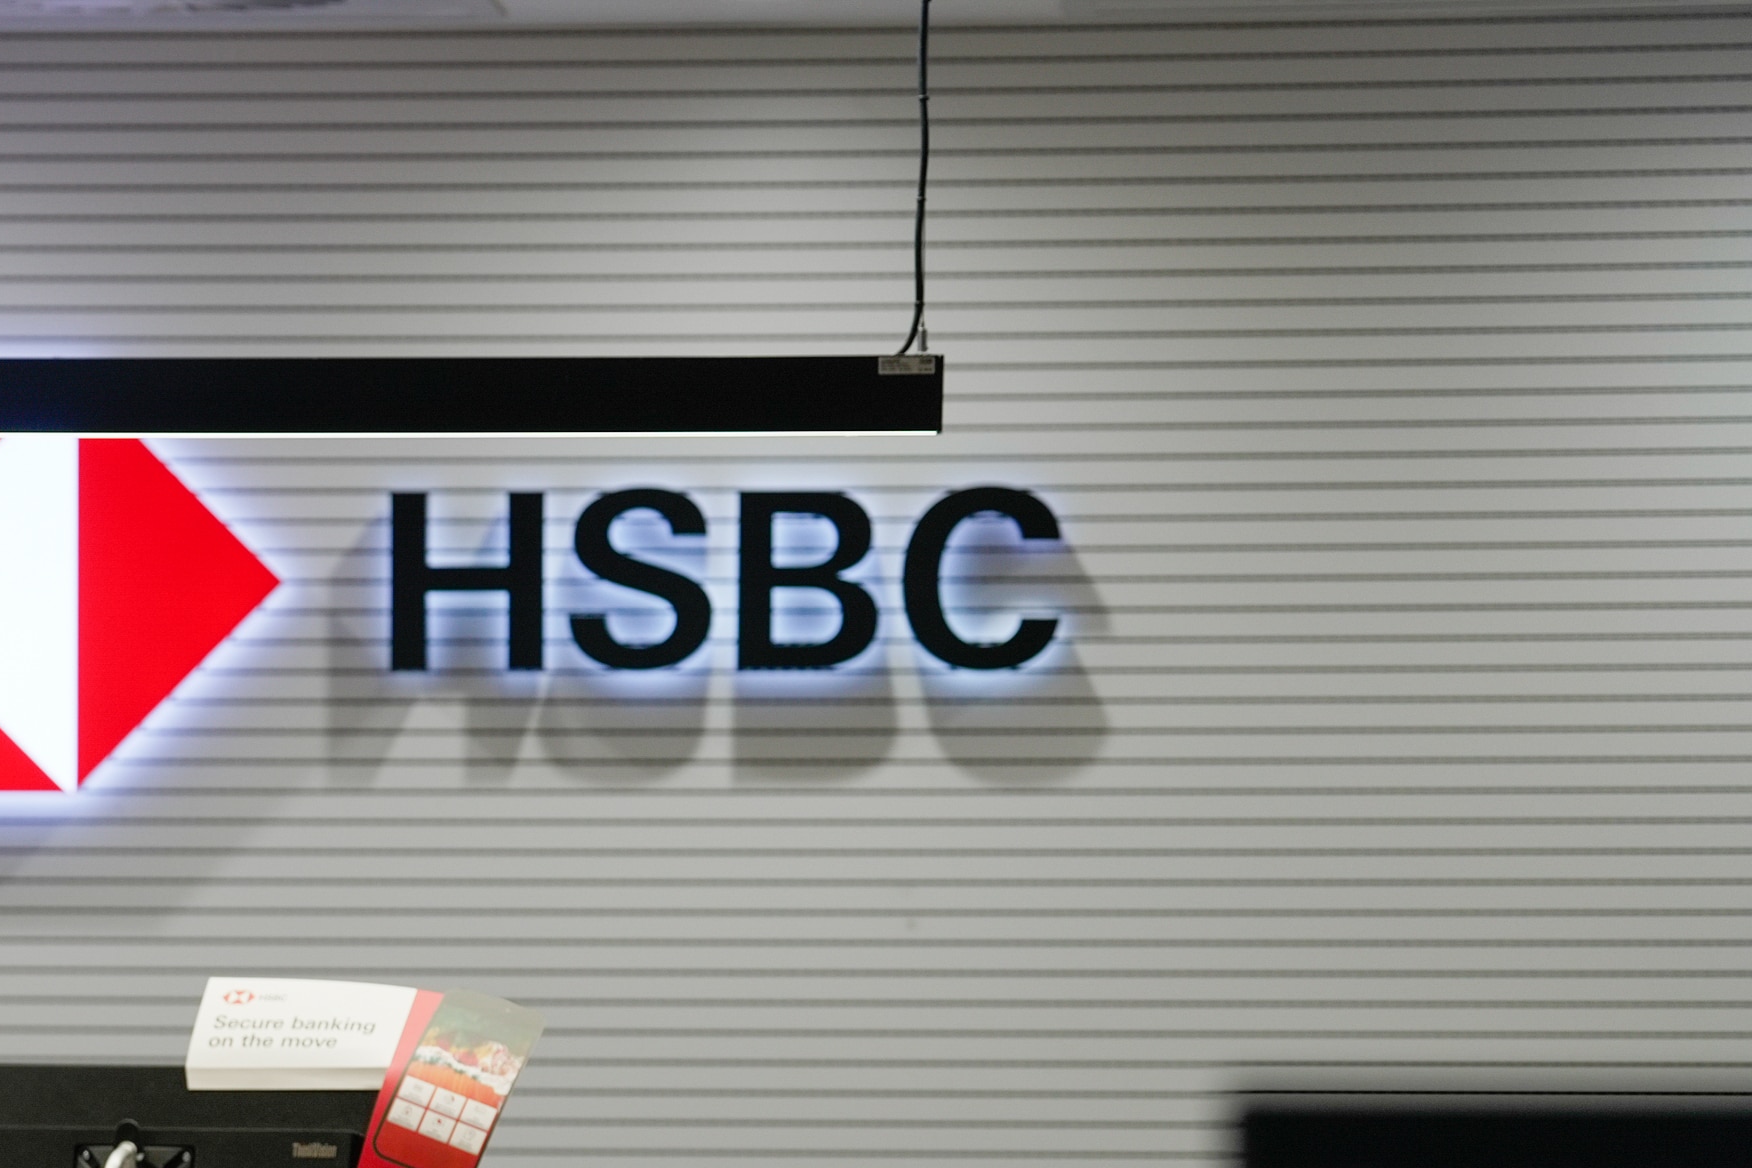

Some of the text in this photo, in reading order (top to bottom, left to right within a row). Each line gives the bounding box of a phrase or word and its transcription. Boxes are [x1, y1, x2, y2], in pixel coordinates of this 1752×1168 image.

[391, 486, 1060, 670] HSBC
[213, 1014, 376, 1035] Secure banking
[208, 1034, 337, 1048] on the move
